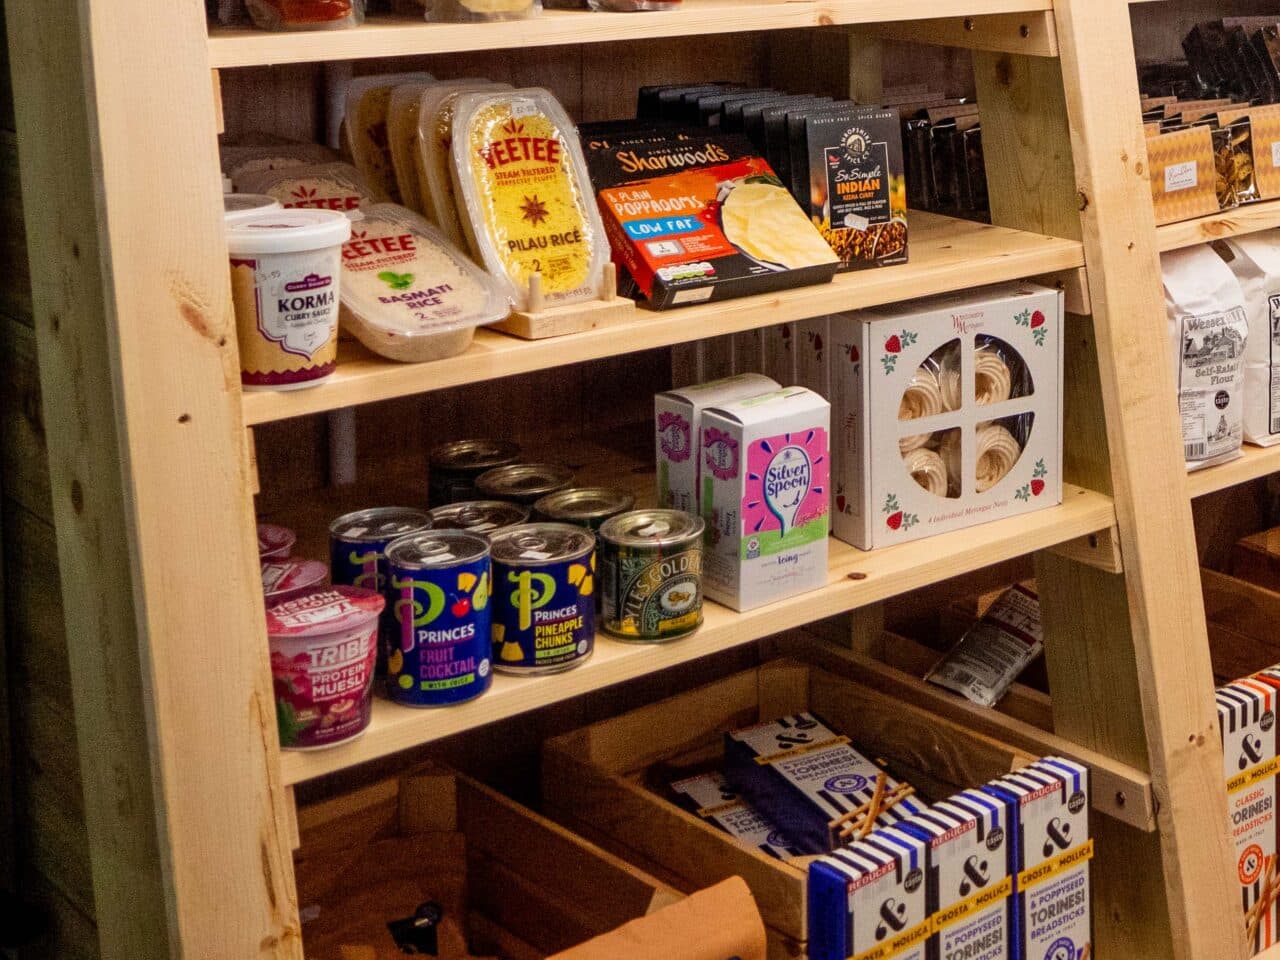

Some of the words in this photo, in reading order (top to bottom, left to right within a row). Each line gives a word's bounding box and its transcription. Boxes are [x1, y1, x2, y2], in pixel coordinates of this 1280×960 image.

[478, 138, 560, 170] VEETEE
[616, 143, 730, 173] Sharwood's
[494, 170, 520, 181] STEAM
[619, 190, 652, 201] PLAIN
[836, 179, 880, 194] INDIAN
[629, 223, 663, 235] LOW
[667, 219, 693, 231] FAT
[508, 236, 548, 253] PILAU
[552, 231, 582, 247] RICE
[278, 291, 334, 312] KORMA
[378, 284, 453, 304] BASMATI
[406, 297, 443, 310] RICE
[284, 313, 310, 321] CURRY
[1187, 315, 1226, 331] Wessex
[768, 463, 808, 484] Silver
[767, 476, 808, 500] spoon
[777, 553, 798, 565] Icing
[534, 605, 577, 621] PRINCES
[418, 624, 475, 643] PRINCES
[535, 616, 583, 637] PINEAPPLE
[535, 632, 573, 649] CHUNKS
[308, 640, 369, 667] TRIBE
[420, 647, 455, 663] FRUIT
[312, 662, 365, 685] PROTEIN
[420, 657, 476, 679] COCKTAIL
[312, 673, 365, 697] MUESLI
[1251, 762, 1278, 779] MOLLICA
[1021, 781, 1062, 807] REDUCED
[1235, 788, 1265, 808] CLASSIC
[1043, 817, 1073, 858] &
[1022, 865, 1052, 884] CROSTA
[1059, 847, 1091, 866] MOLLICA
[1039, 877, 1085, 906] POPPYSEED
[936, 904, 968, 925] CROSTA
[975, 883, 1009, 906] MOLLICA
[1030, 888, 1086, 926] TORINESI
[954, 915, 1002, 945] POPPYSEED
[1030, 907, 1086, 940] BREADSTICKS
[892, 927, 929, 951] MOLLICA
